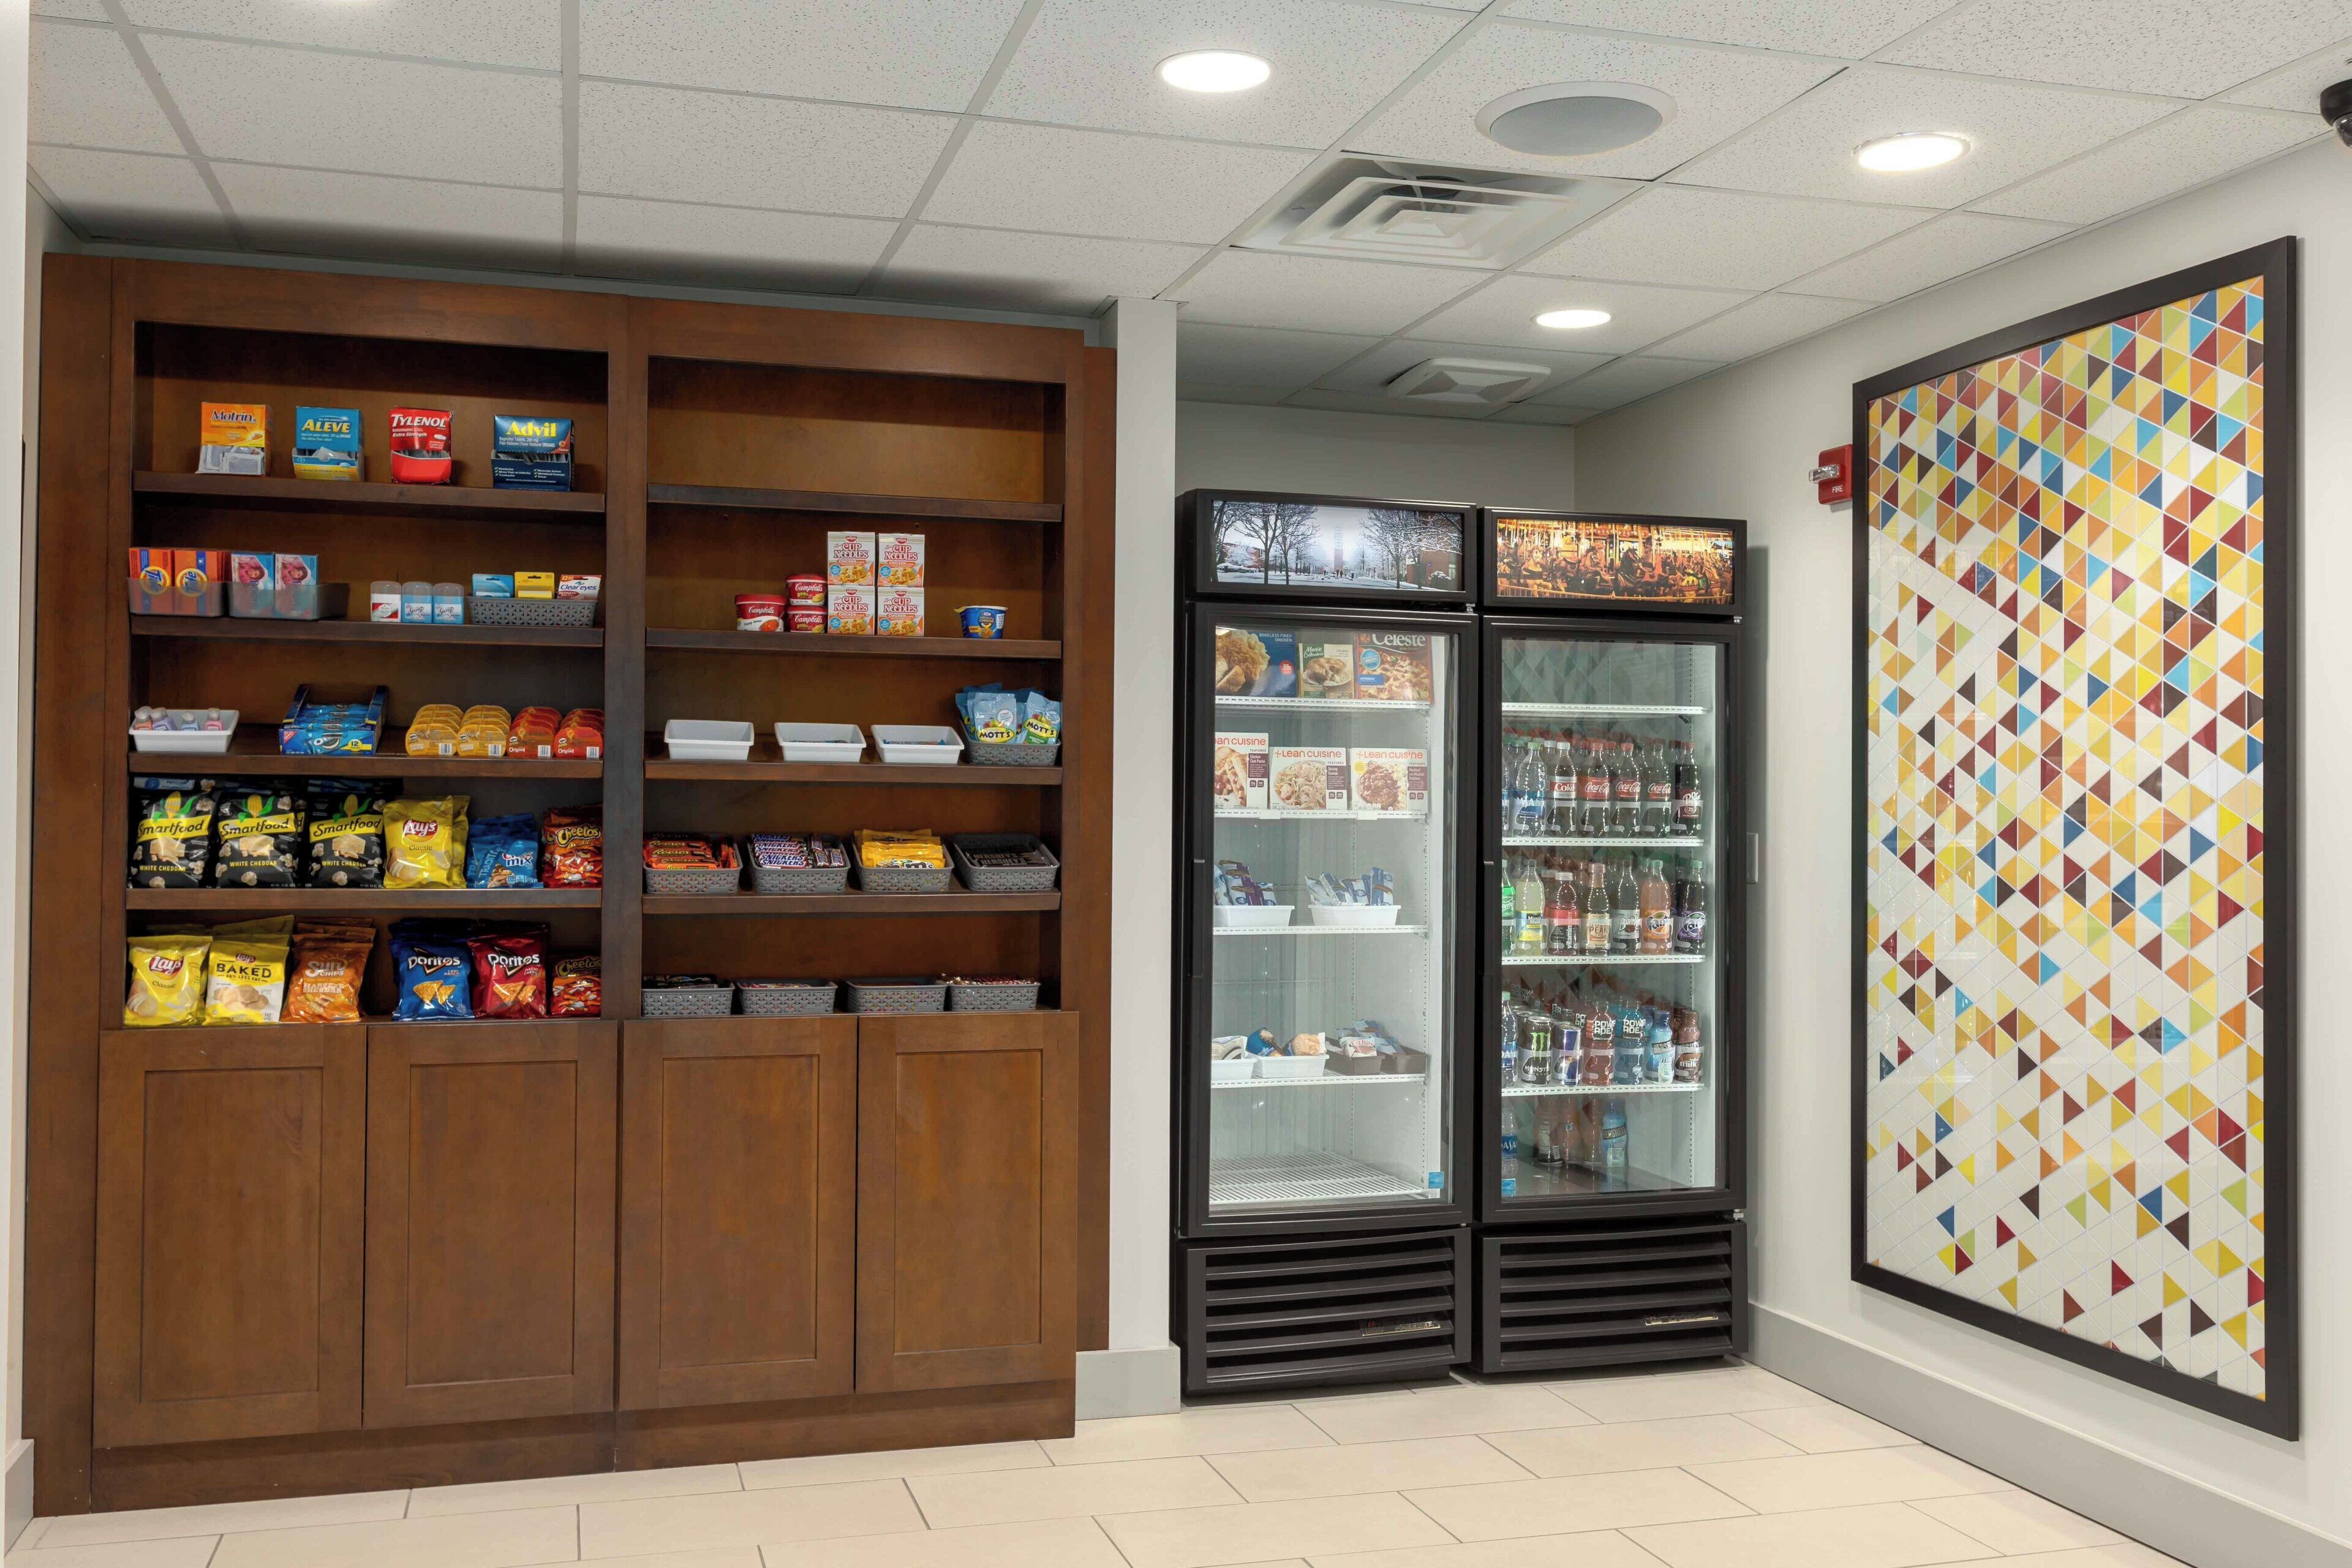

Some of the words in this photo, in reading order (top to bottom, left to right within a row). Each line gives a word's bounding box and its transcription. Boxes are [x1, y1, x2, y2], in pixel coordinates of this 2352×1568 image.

[211, 409, 252, 421] Motrin
[391, 414, 446, 428] TYLENOL
[301, 420, 350, 433] ALEVE
[506, 421, 556, 437] Advil
[1833, 485, 1843, 494] FIRE
[834, 550, 869, 559] NOODLES
[834, 603, 869, 612] NOODLES
[883, 605, 918, 613] NOODLES
[1372, 633, 1427, 646] Celeste
[138, 820, 204, 838] Smartfood
[221, 818, 290, 837] Smartfood
[313, 818, 381, 837] Smartfood
[404, 820, 435, 837] Lay's
[557, 827, 599, 845] Cheetos
[236, 953, 255, 963] Lay's
[408, 956, 461, 970] Doritos
[488, 953, 540, 968] Doritos
[149, 956, 184, 975] Lay's
[216, 963, 272, 978] BAKED
[152, 980, 176, 989] Classic
